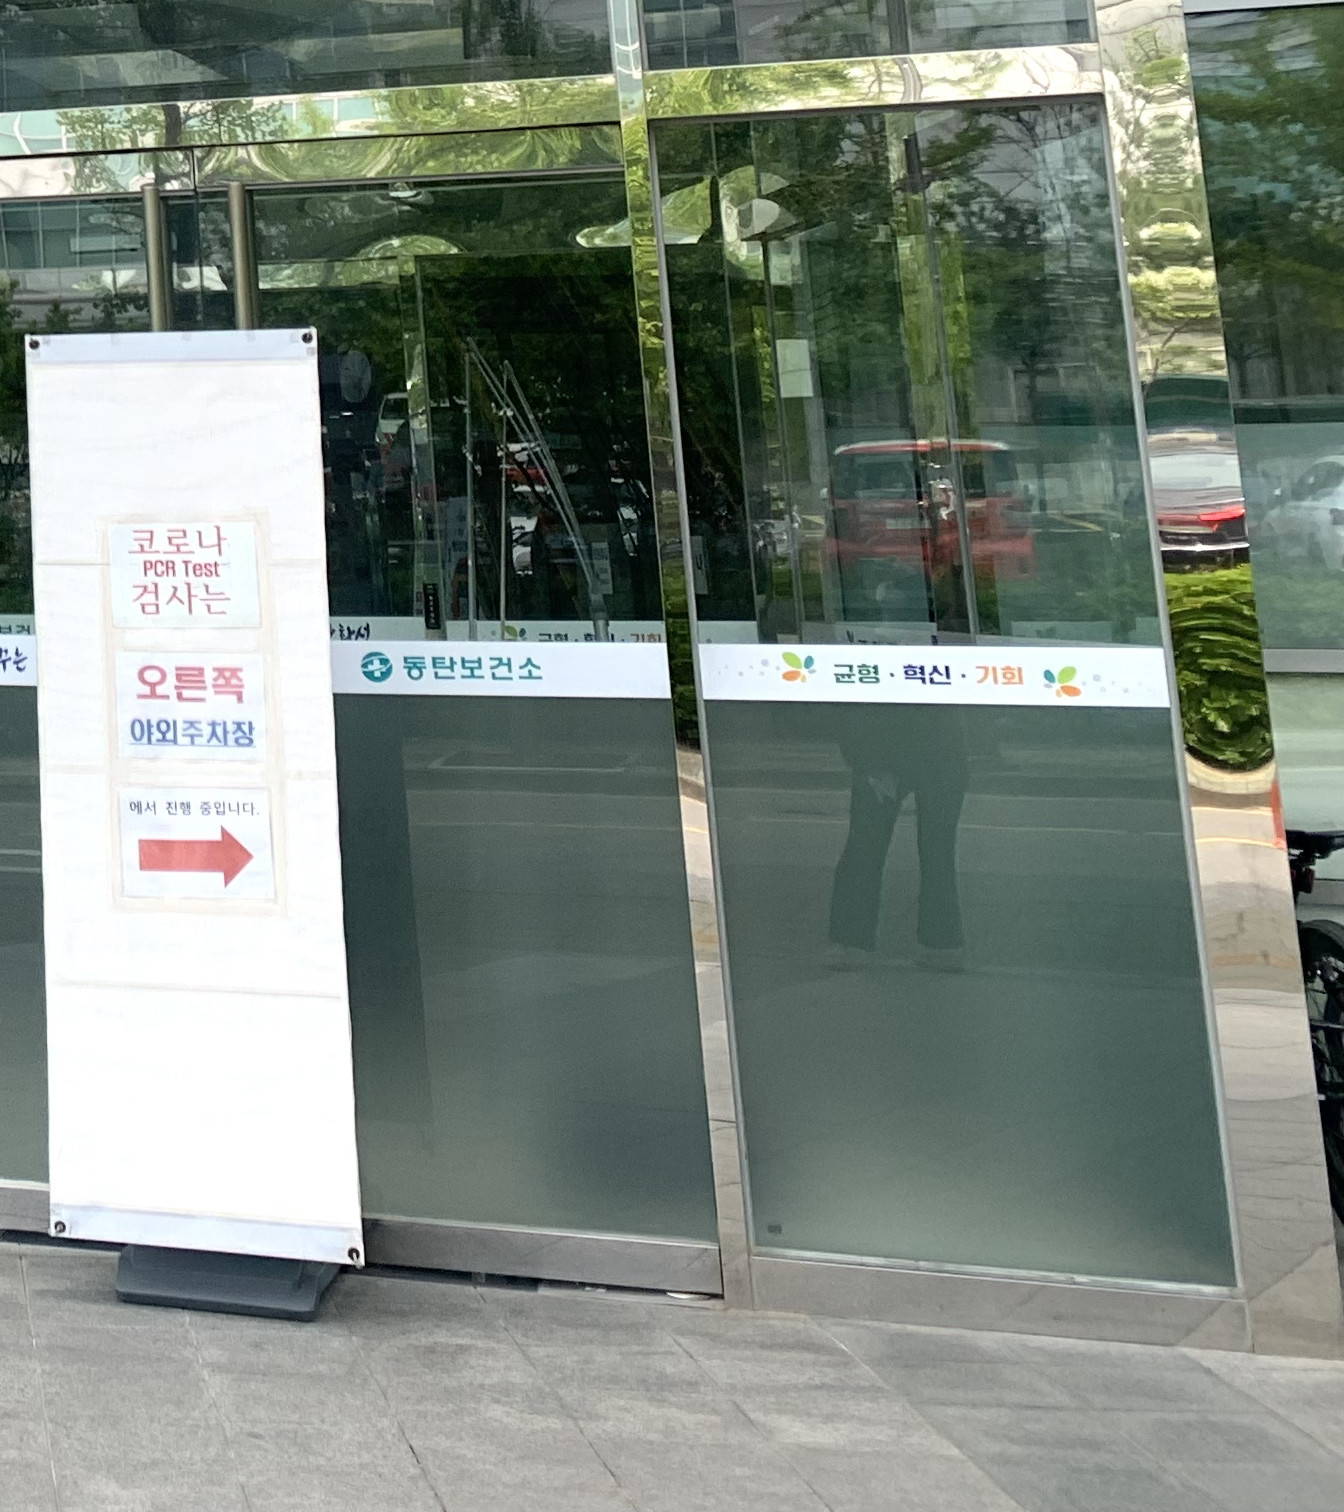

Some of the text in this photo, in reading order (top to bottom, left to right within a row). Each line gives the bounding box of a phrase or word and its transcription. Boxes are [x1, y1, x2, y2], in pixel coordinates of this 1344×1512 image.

[128, 525, 228, 557] 코로나
[143, 559, 221, 578] PCR Test
[132, 582, 232, 616] 검사는
[402, 655, 544, 682] 동탄보건소
[833, 663, 1025, 687] 균형 혁신 기회
[136, 664, 246, 704] 오른쪽
[130, 717, 256, 748] 야외주차장
[130, 800, 261, 818] 에서 진행 중입니다.
